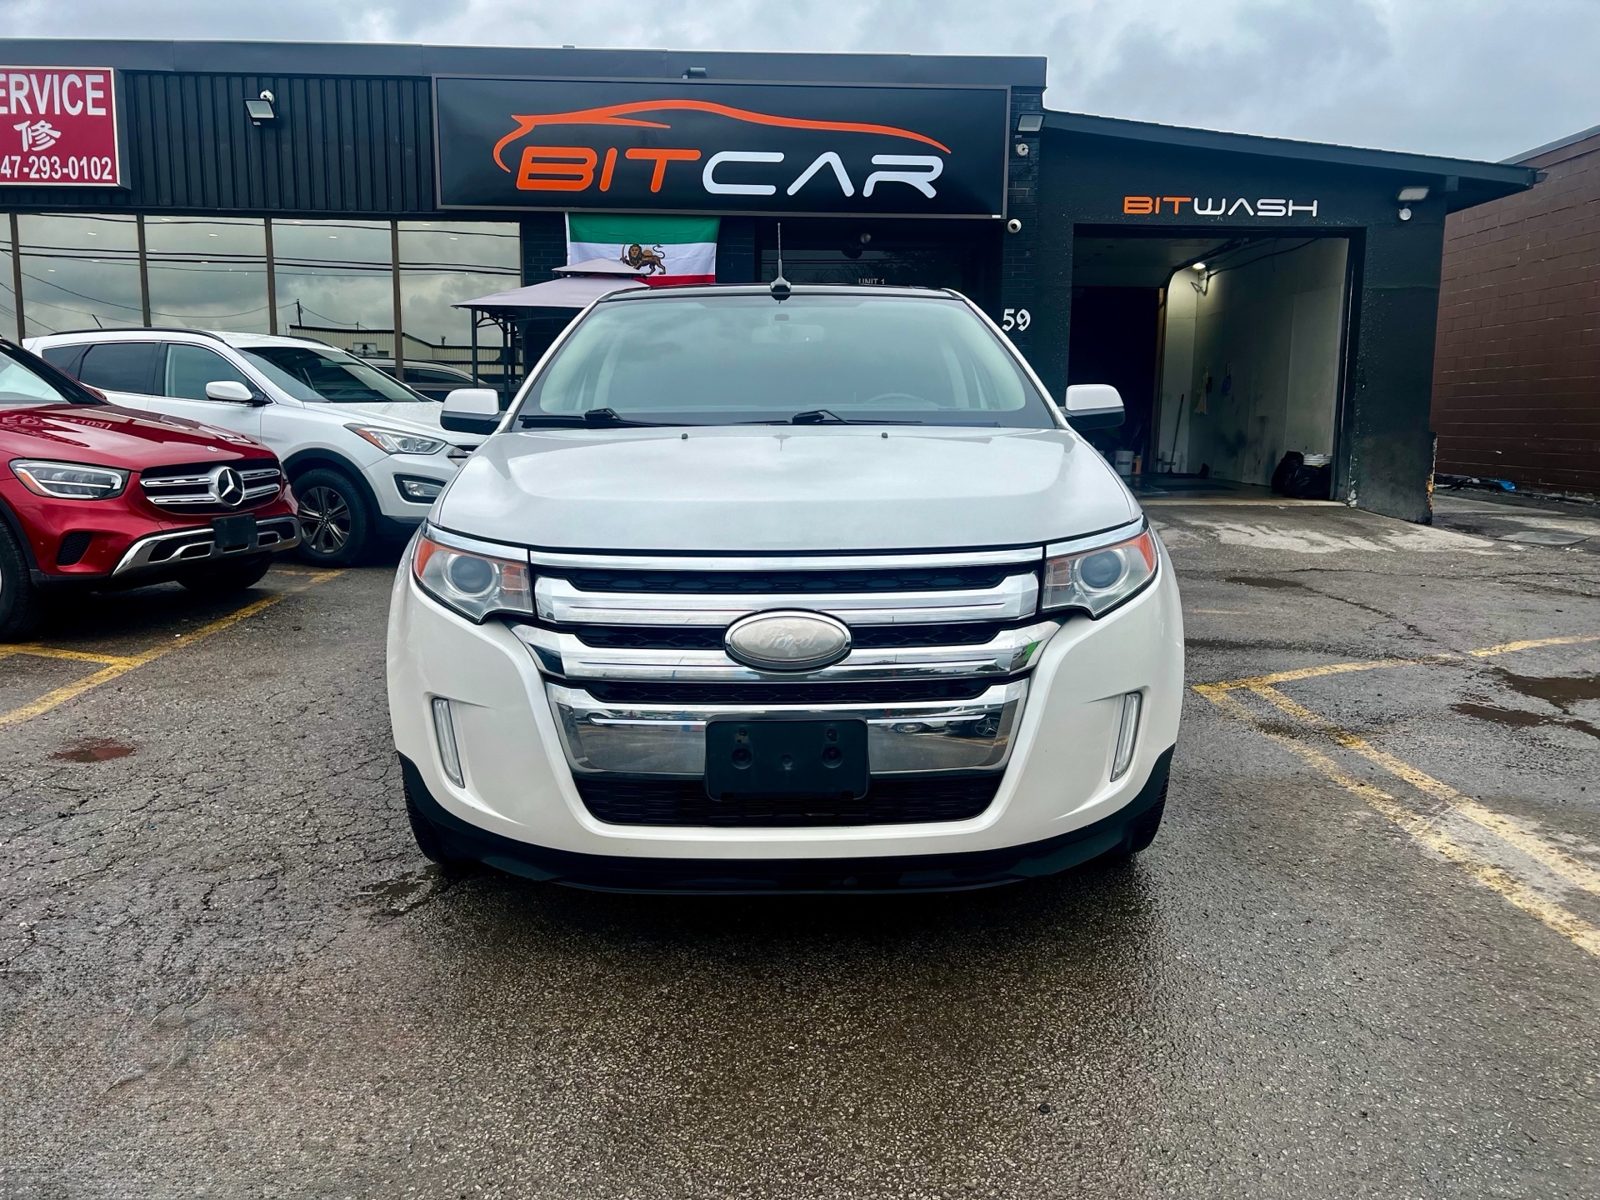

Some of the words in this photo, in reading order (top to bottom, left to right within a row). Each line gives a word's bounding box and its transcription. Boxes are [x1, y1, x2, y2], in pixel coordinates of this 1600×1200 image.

[13, 120, 62, 152] 修
[515, 145, 944, 198] BITCAR
[1123, 196, 1318, 217] BITWASH
[1001, 308, 1031, 332] 59
